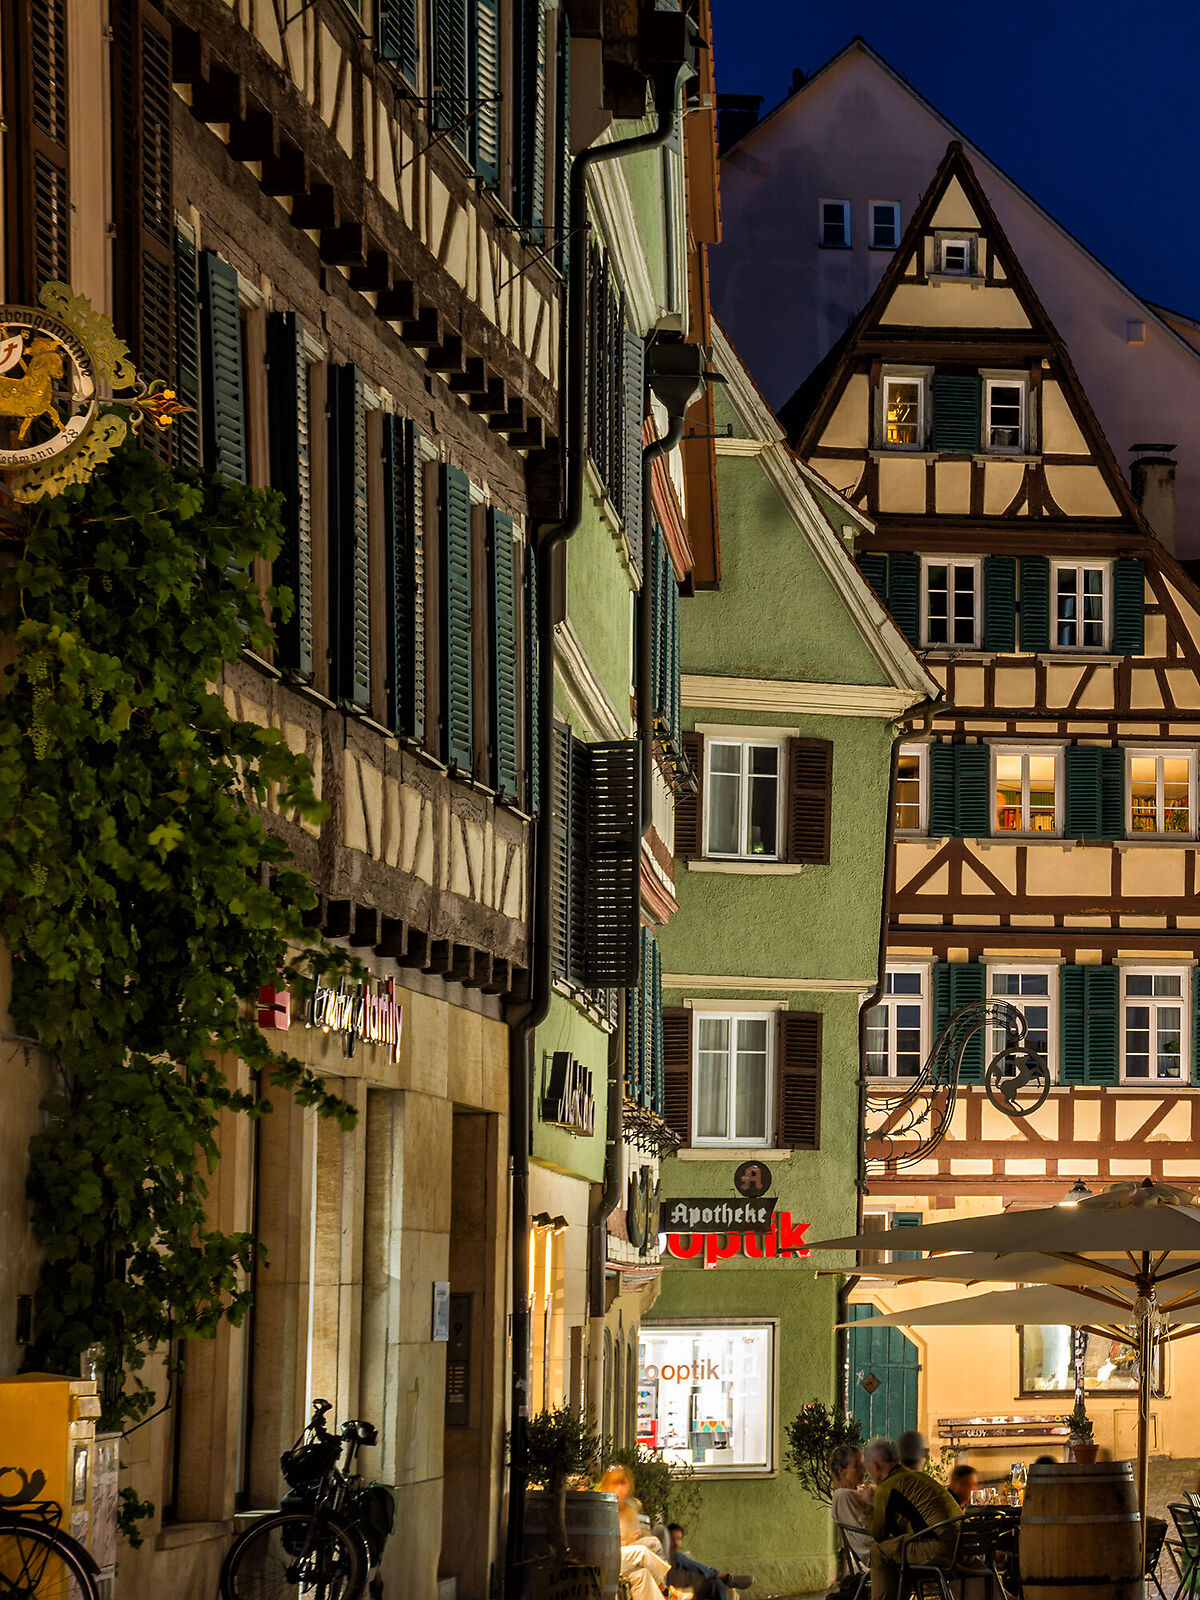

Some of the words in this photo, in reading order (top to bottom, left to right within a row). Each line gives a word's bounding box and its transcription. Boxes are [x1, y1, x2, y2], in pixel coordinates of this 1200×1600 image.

[60, 428, 80, 446] 28
[0, 446, 56, 465] eckmann
[740, 1164, 764, 1191] A
[670, 1202, 768, 1228] Apotheke
